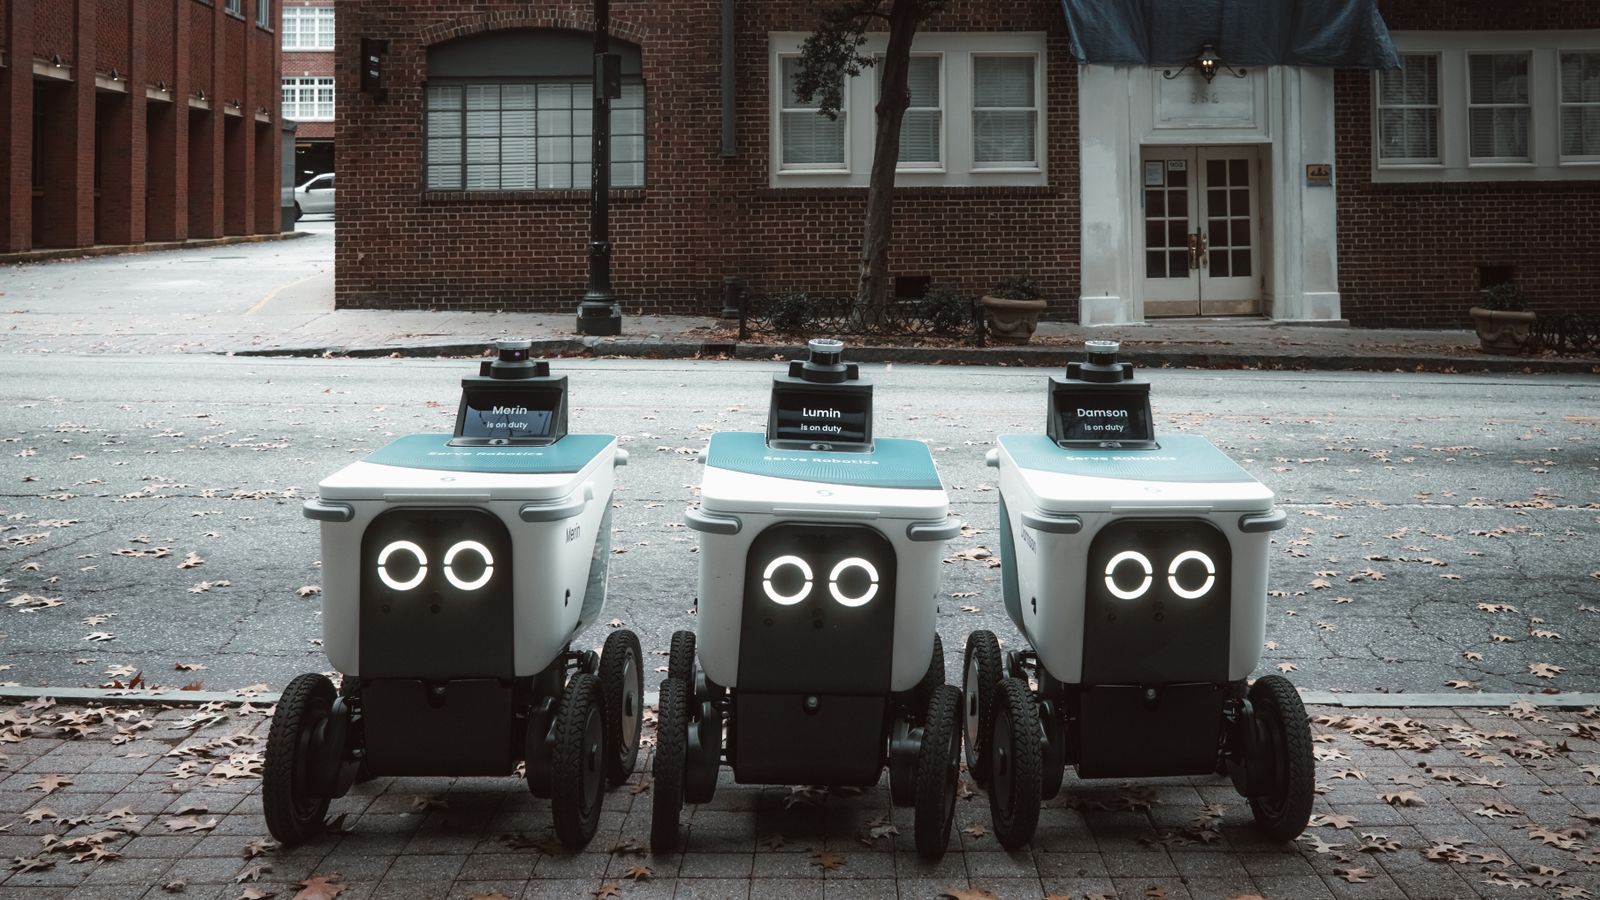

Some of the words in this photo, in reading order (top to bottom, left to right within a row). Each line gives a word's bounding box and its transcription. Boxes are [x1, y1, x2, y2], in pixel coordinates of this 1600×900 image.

[492, 405, 528, 415] Merin
[802, 407, 841, 418] Lumin
[1077, 408, 1128, 418] Damson
[508, 421, 528, 430] duty
[822, 424, 842, 433] duty
[1105, 424, 1124, 432] duty
[566, 522, 581, 543] Merin
